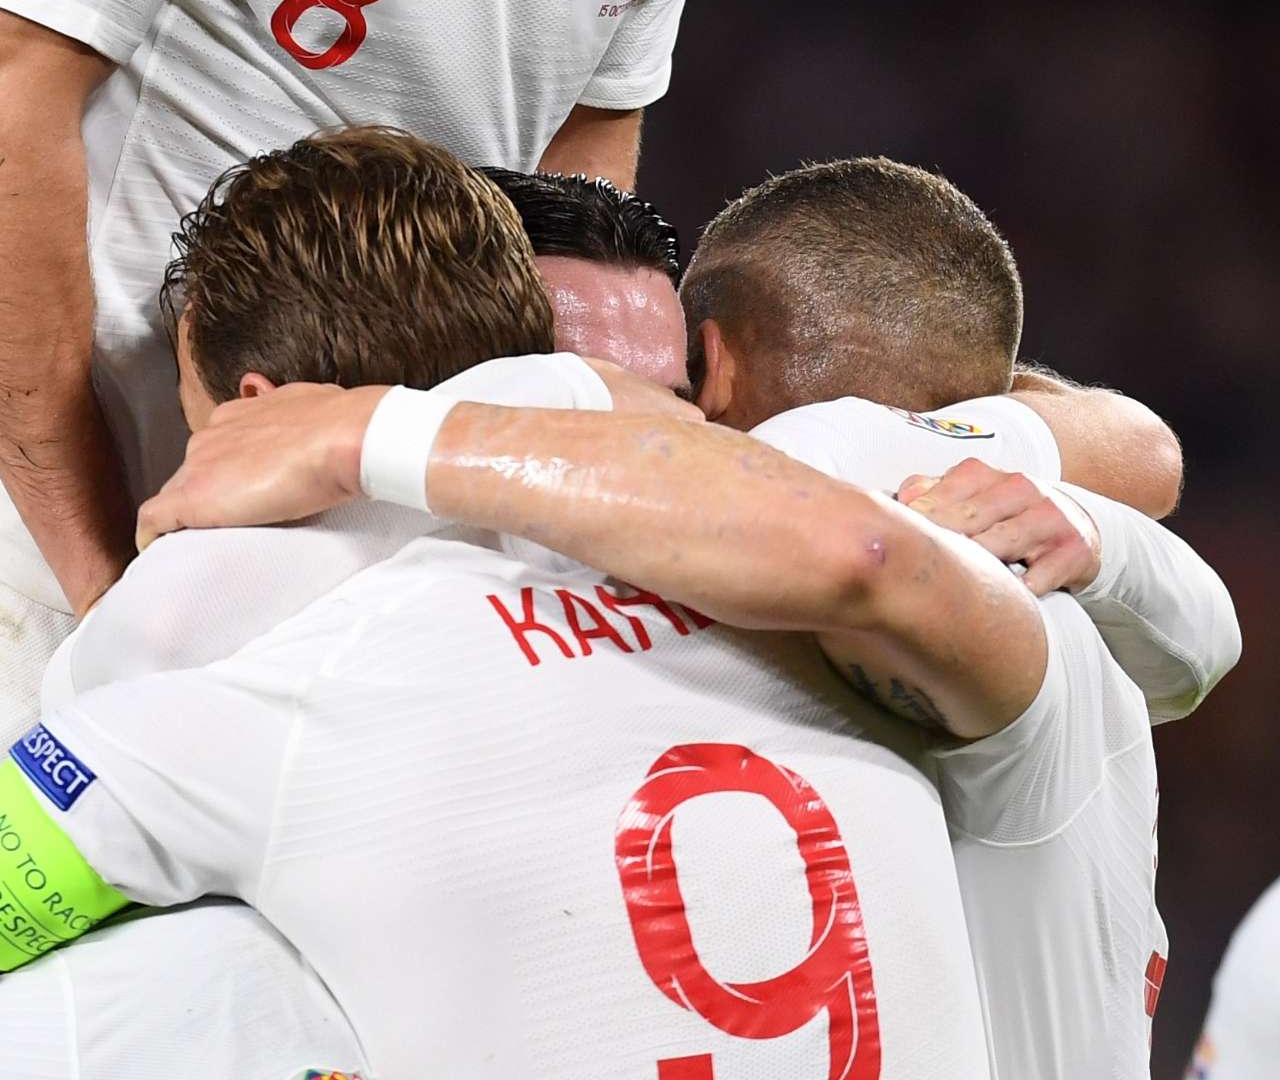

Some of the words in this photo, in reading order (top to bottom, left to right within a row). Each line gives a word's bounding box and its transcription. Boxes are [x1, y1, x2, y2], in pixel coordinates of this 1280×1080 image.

[485, 580, 716, 666] KAN
[16, 853, 48, 891] TO
[42, 891, 94, 931] RAC
[615, 742, 882, 1080] 9
